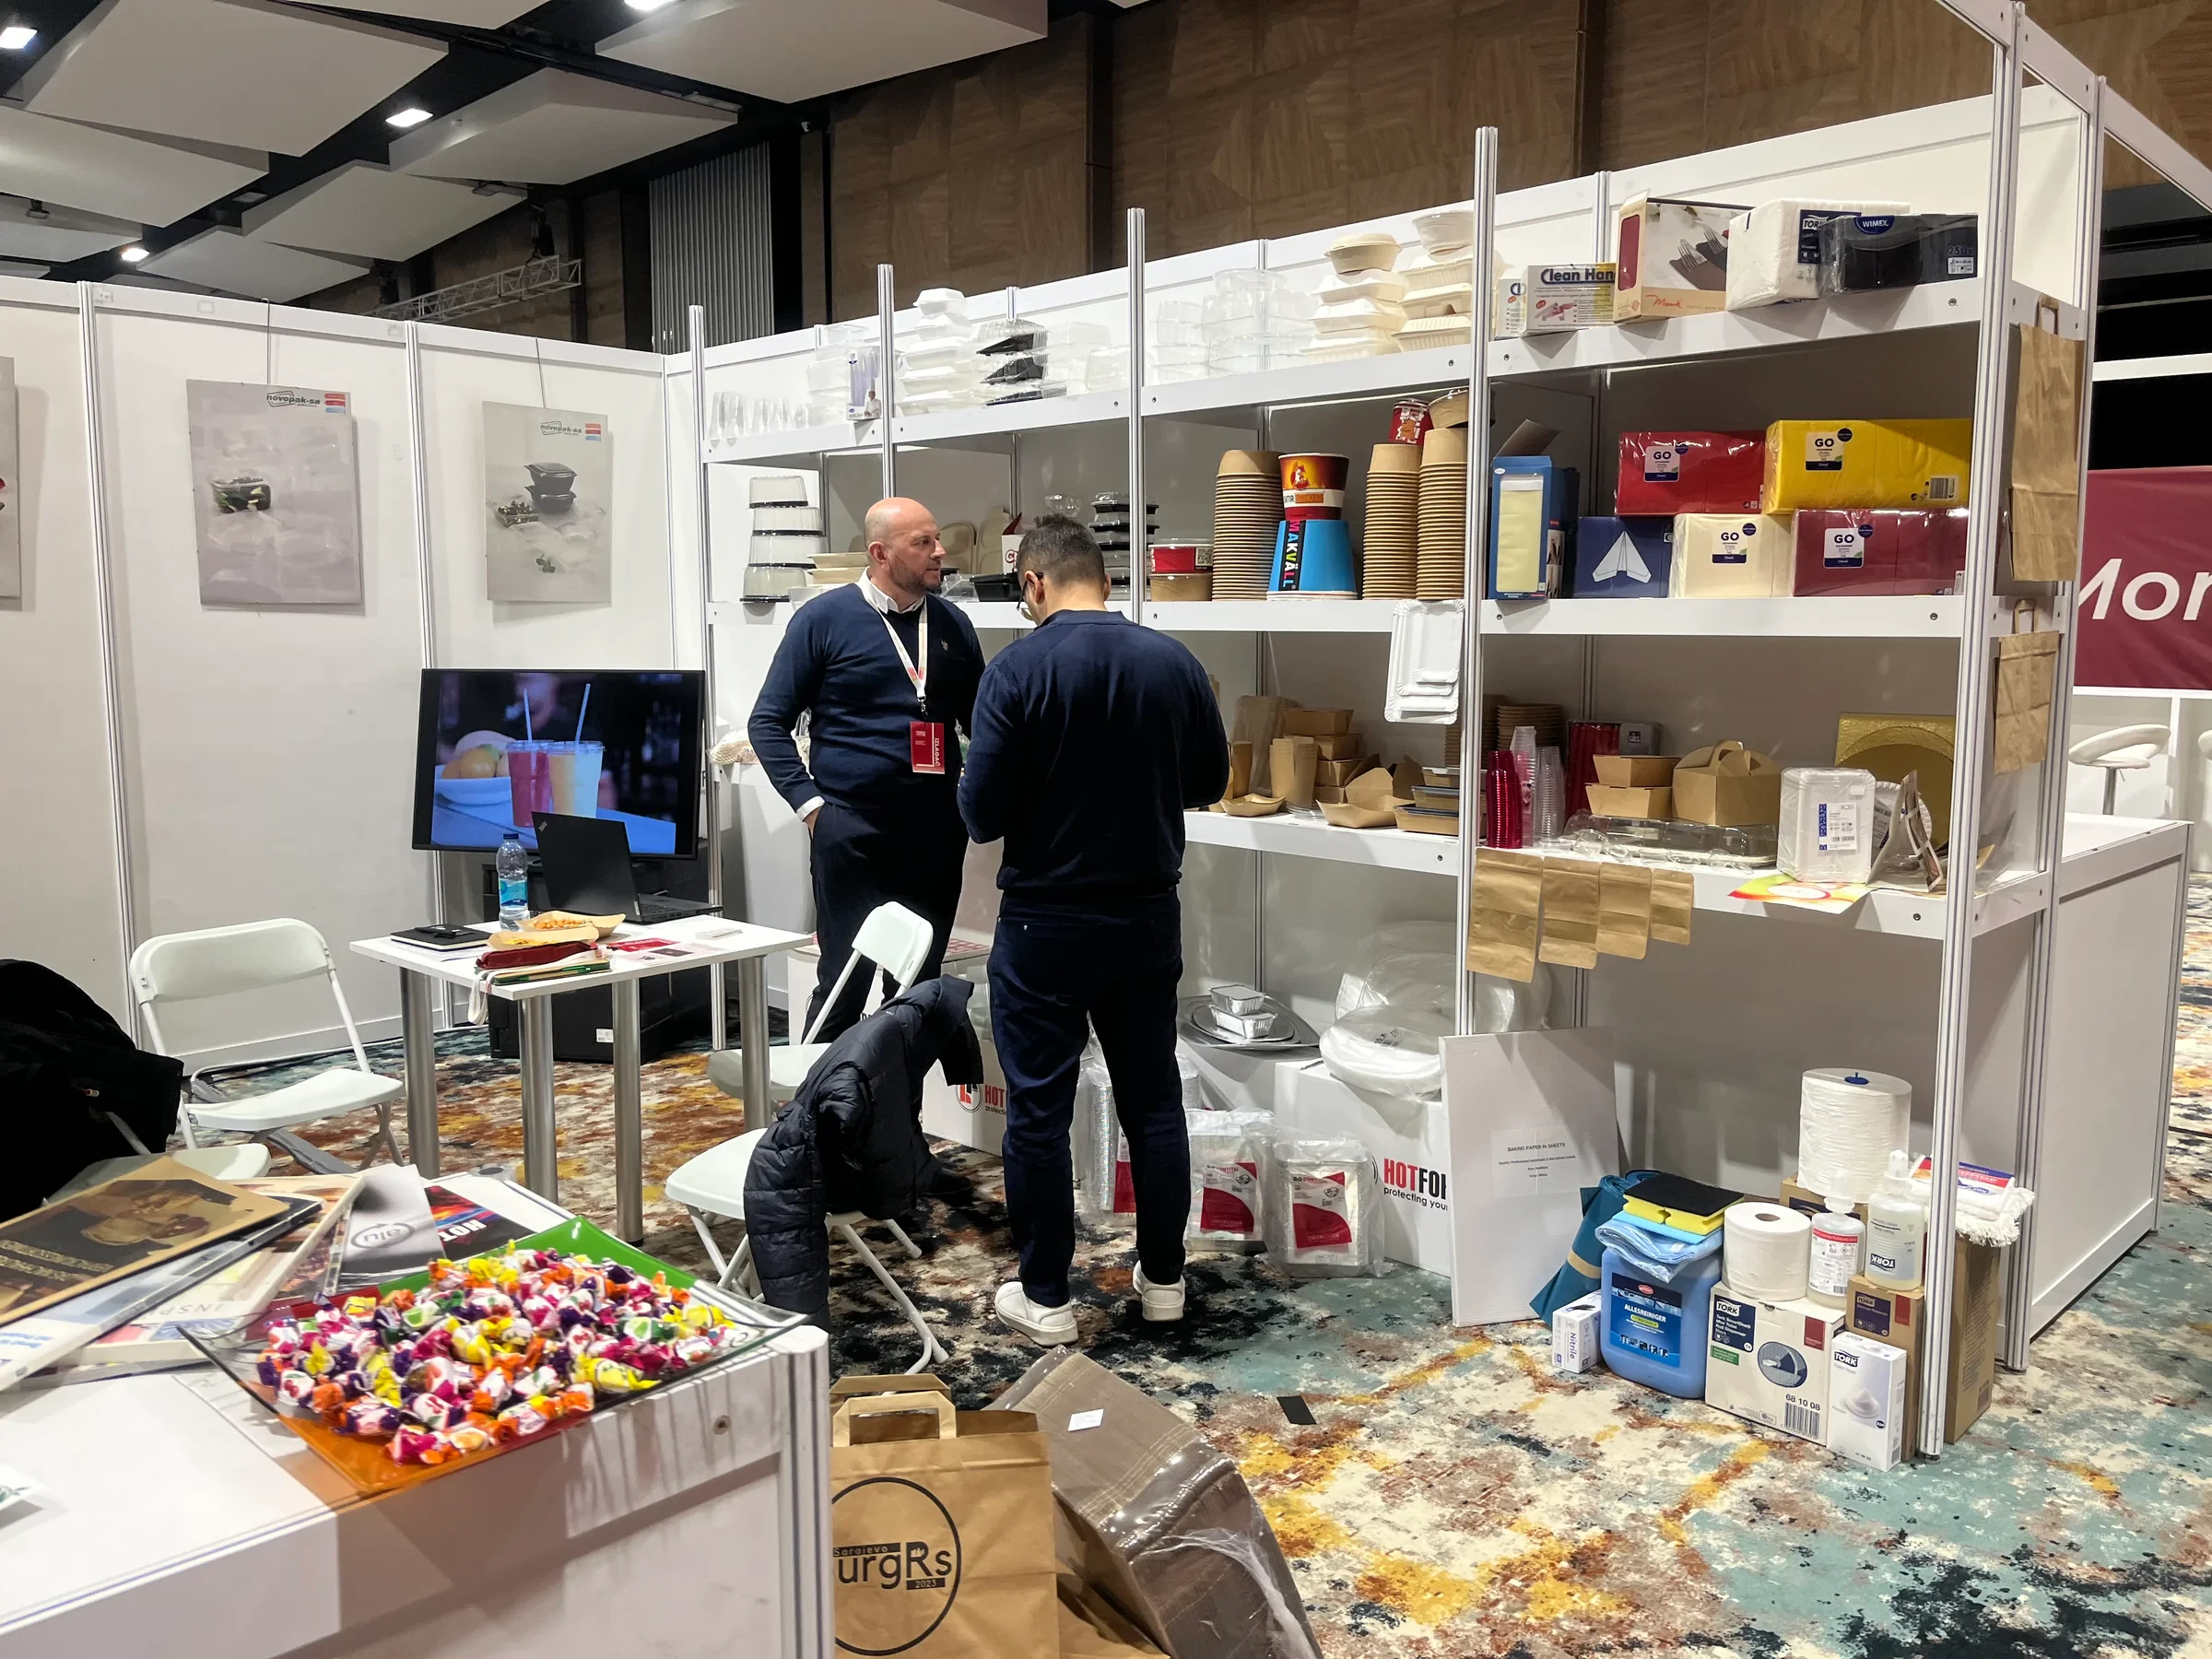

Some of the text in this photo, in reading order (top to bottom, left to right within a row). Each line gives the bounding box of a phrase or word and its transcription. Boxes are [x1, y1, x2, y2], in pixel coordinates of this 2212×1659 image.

[1862, 218, 1889, 229] WIMEX
[1540, 268, 1581, 284] Clean
[265, 394, 321, 405] novopak-sa
[540, 424, 582, 434] novopak-sa
[1815, 438, 1834, 447] GO
[1653, 451, 1672, 460] GO
[1720, 532, 1740, 541] GO
[1834, 534, 1855, 544] GO
[1383, 1186, 1428, 1206] protecting
[438, 1218, 488, 1242] HOT
[1871, 1254, 1894, 1267] TORK
[1858, 1296, 1874, 1305] TORK
[150, 1303, 225, 1316] INSP
[1624, 1303, 1666, 1323] ALLESREINIGER
[1717, 1302, 1739, 1315] TORK
[1834, 1352, 1857, 1367] TORK
[1785, 1394, 1821, 1411] 68 10 08
[838, 1541, 952, 1590] urgRs
[915, 1579, 937, 1589] 2023
